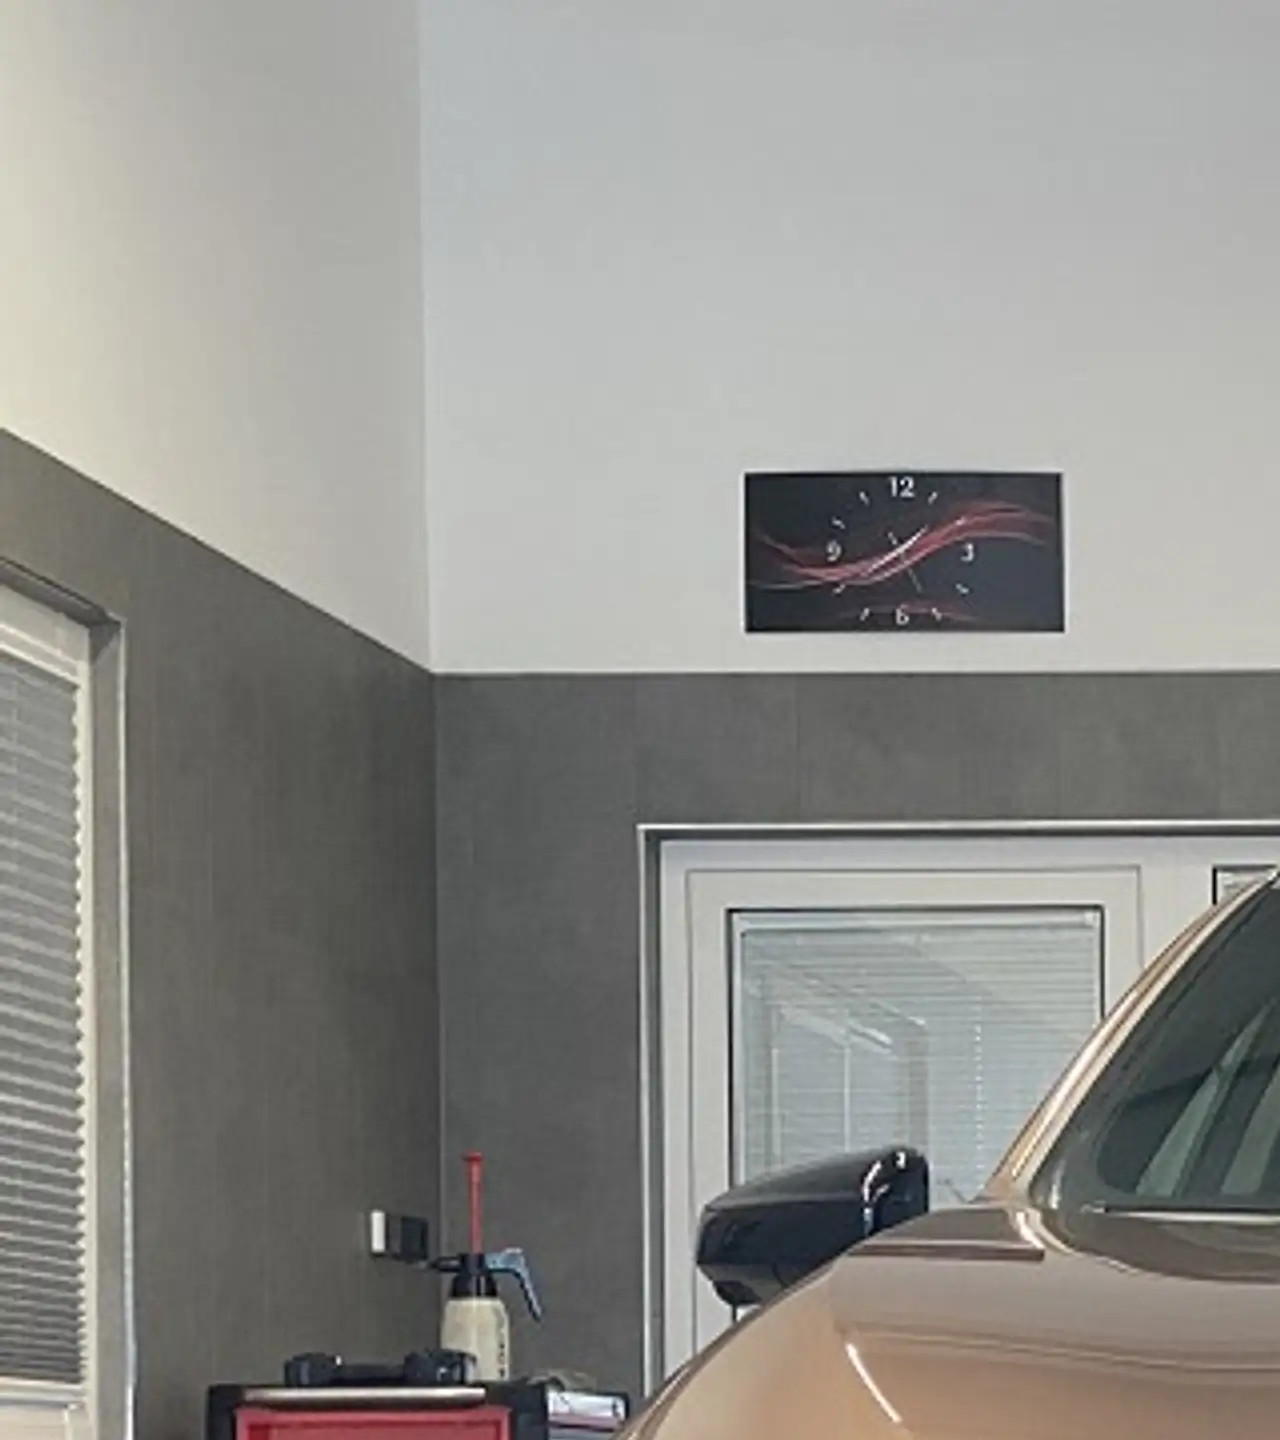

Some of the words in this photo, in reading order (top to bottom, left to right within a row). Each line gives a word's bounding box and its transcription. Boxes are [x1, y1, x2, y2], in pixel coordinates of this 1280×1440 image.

[888, 476, 916, 498] 12
[827, 540, 842, 562] 9
[960, 543, 975, 562] 3
[895, 604, 910, 625] 6
